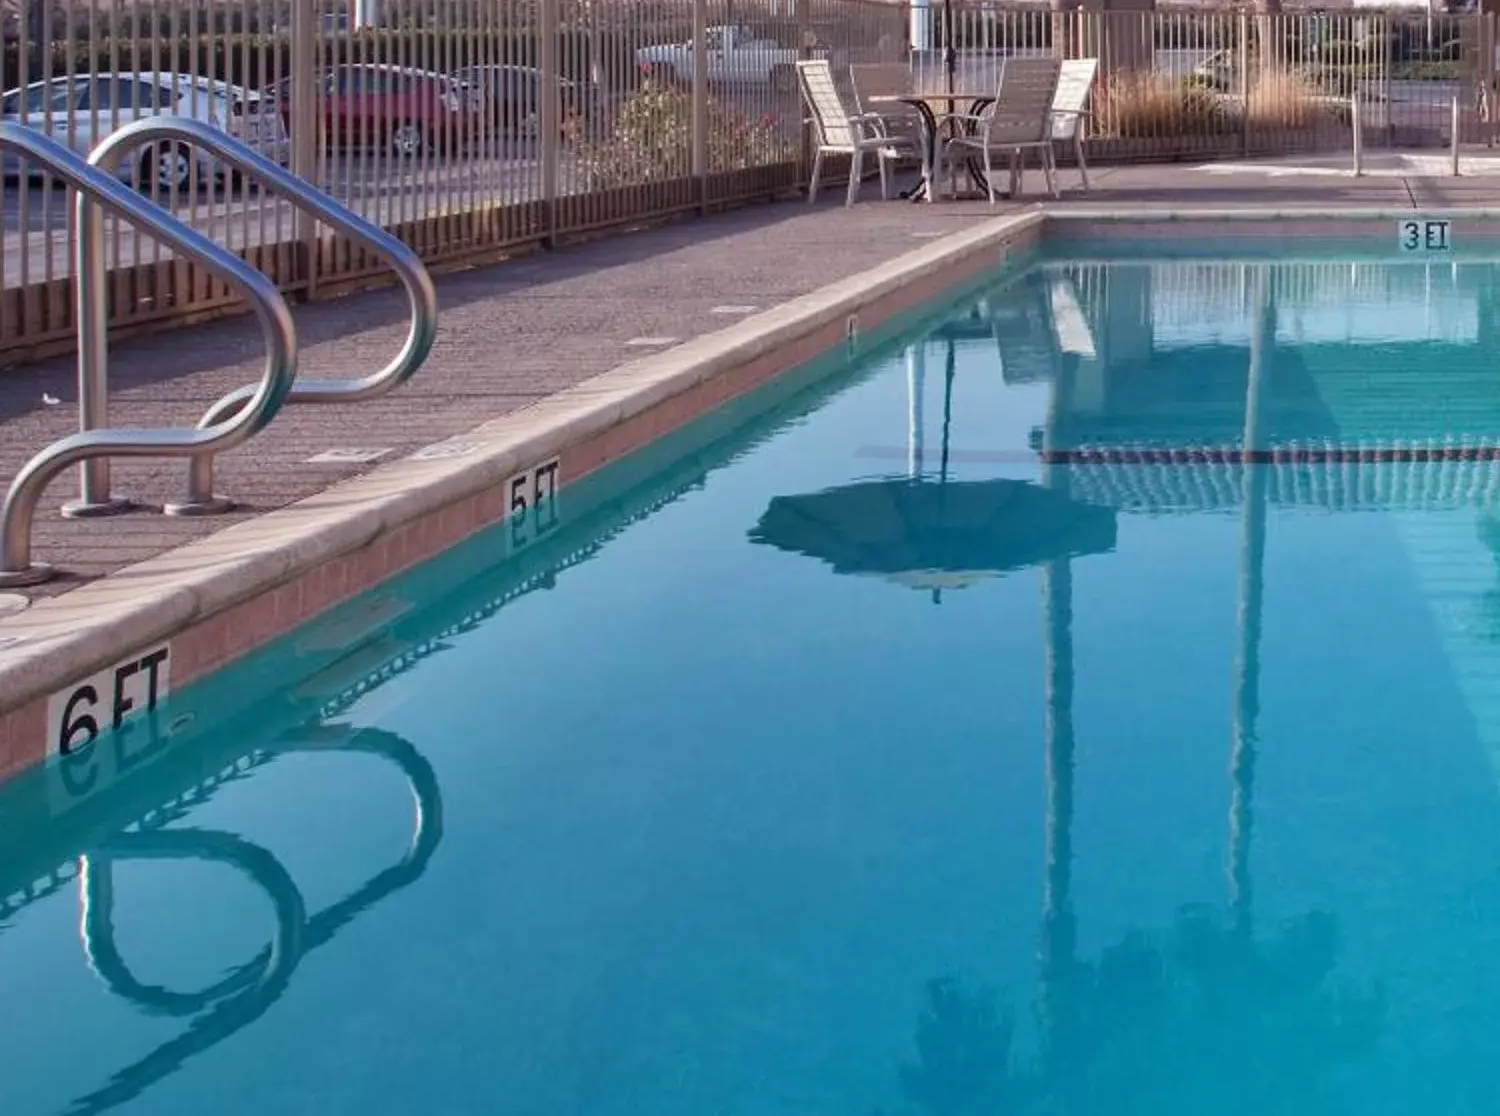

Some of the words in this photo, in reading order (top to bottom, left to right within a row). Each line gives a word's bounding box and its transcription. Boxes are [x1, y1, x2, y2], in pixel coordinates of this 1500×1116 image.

[511, 475, 526, 516] 5
[534, 460, 559, 510] FT
[60, 685, 98, 756] 6
[112, 648, 168, 729] FT
